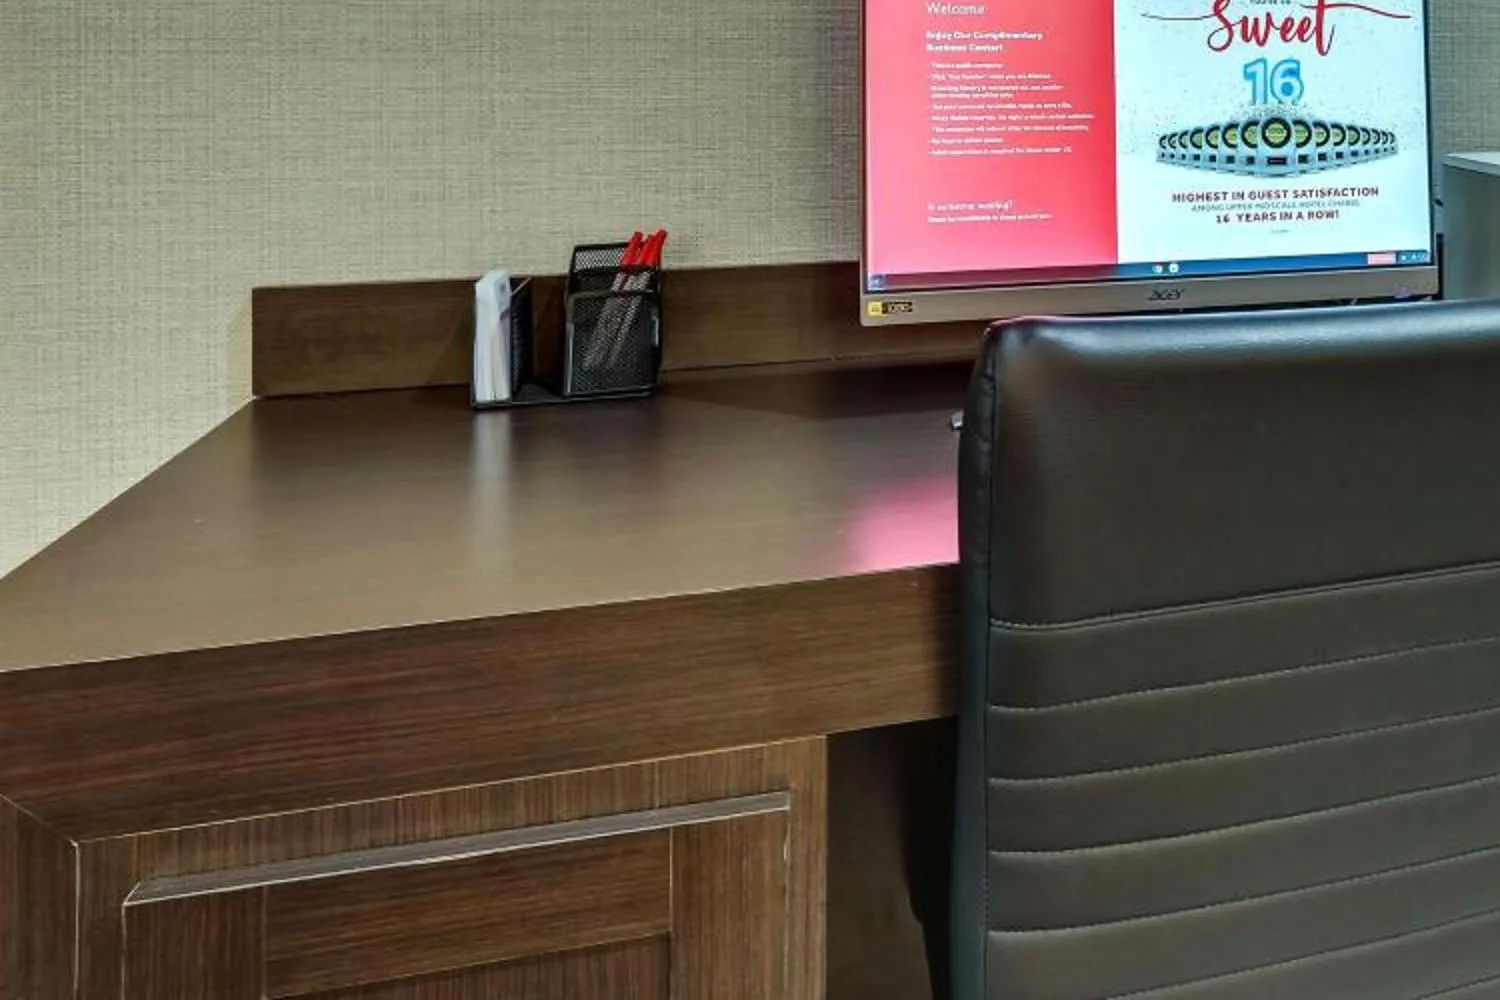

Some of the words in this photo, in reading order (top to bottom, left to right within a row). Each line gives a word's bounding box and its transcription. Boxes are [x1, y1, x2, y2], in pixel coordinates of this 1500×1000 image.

[926, 1, 985, 15] Welcome
[1243, 57, 1305, 106] 16
[1172, 191, 1228, 203] HIGHEST
[1231, 191, 1245, 201] IN
[1249, 189, 1289, 201] GUEST
[1292, 186, 1379, 200] SATISFACTION
[1216, 214, 1230, 224] 16
[1236, 211, 1277, 223] YEARS
[1279, 210, 1293, 221] IN
[1295, 210, 1305, 221] A
[1147, 288, 1186, 301] acer
